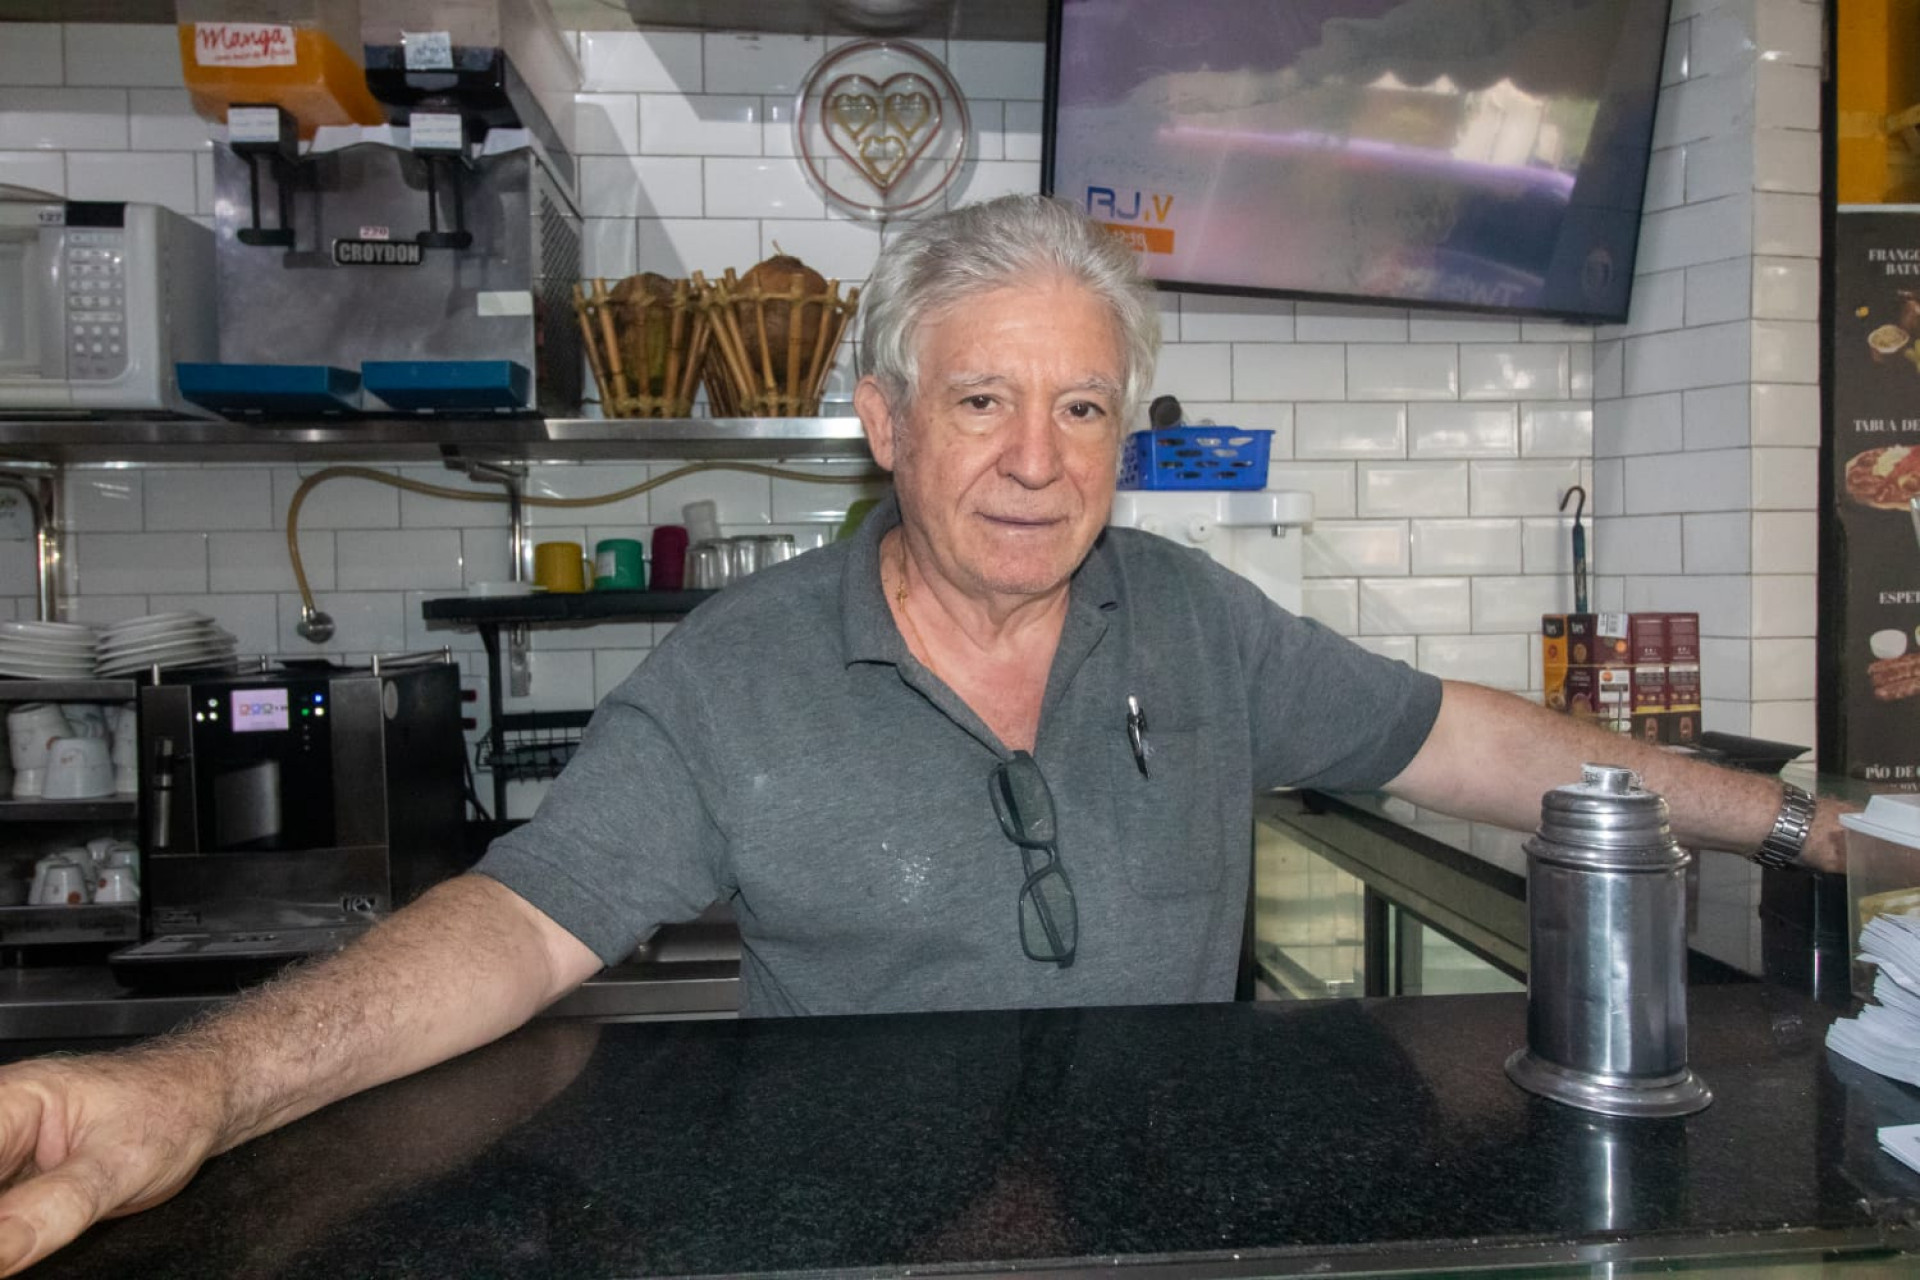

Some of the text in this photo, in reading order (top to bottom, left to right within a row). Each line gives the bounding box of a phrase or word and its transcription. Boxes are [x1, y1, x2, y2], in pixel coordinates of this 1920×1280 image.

[198, 26, 287, 56] Manga
[340, 242, 420, 262] CROYDON
[1865, 763, 1891, 779] PÃO
[1895, 766, 1914, 778] DE
